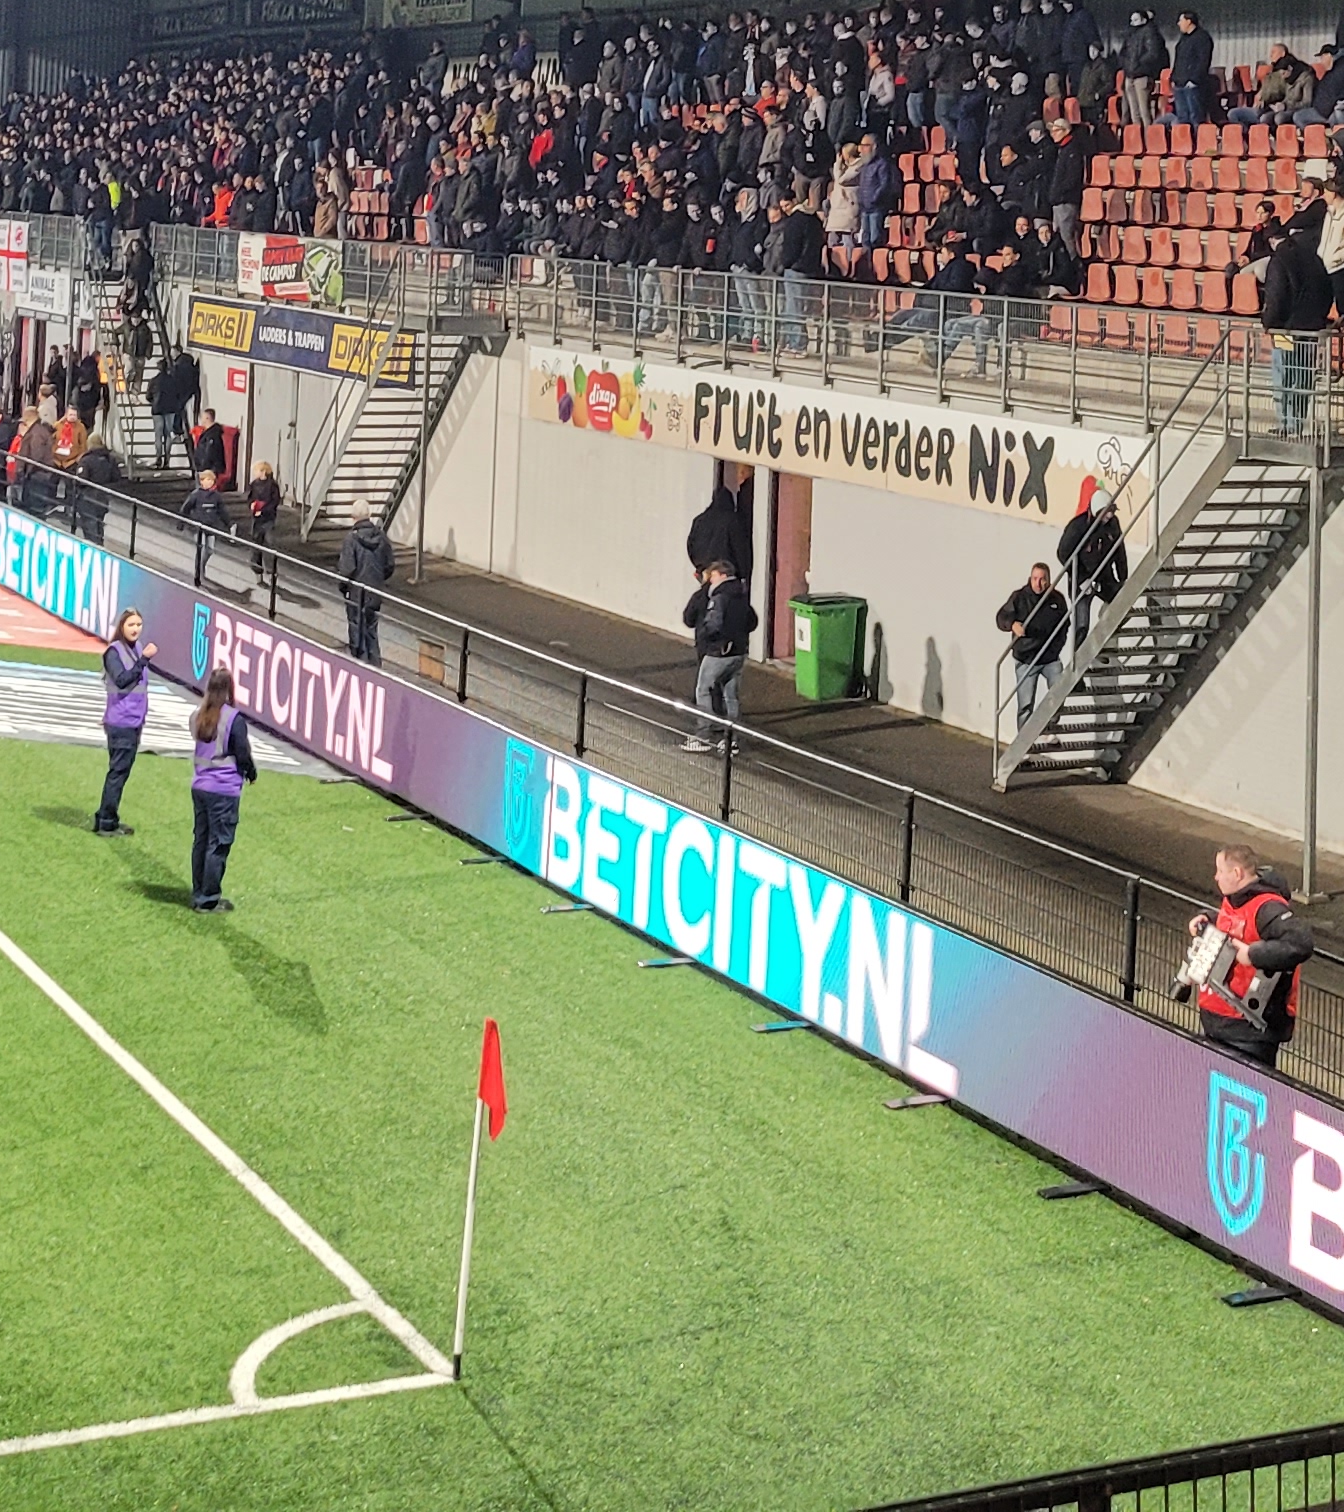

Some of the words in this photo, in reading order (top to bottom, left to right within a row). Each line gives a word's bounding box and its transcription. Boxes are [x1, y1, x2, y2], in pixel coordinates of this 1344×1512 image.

[191, 310, 236, 340] DIRKS
[258, 325, 287, 346] LADDERS
[286, 331, 294, 347] &
[294, 331, 325, 353] TRAPPEN
[588, 383, 617, 413] dixap
[693, 381, 783, 459] Fruit
[794, 404, 832, 463] en
[212, 612, 395, 785] BETCITY.NL
[541, 758, 960, 1100] BETCITY.NL
